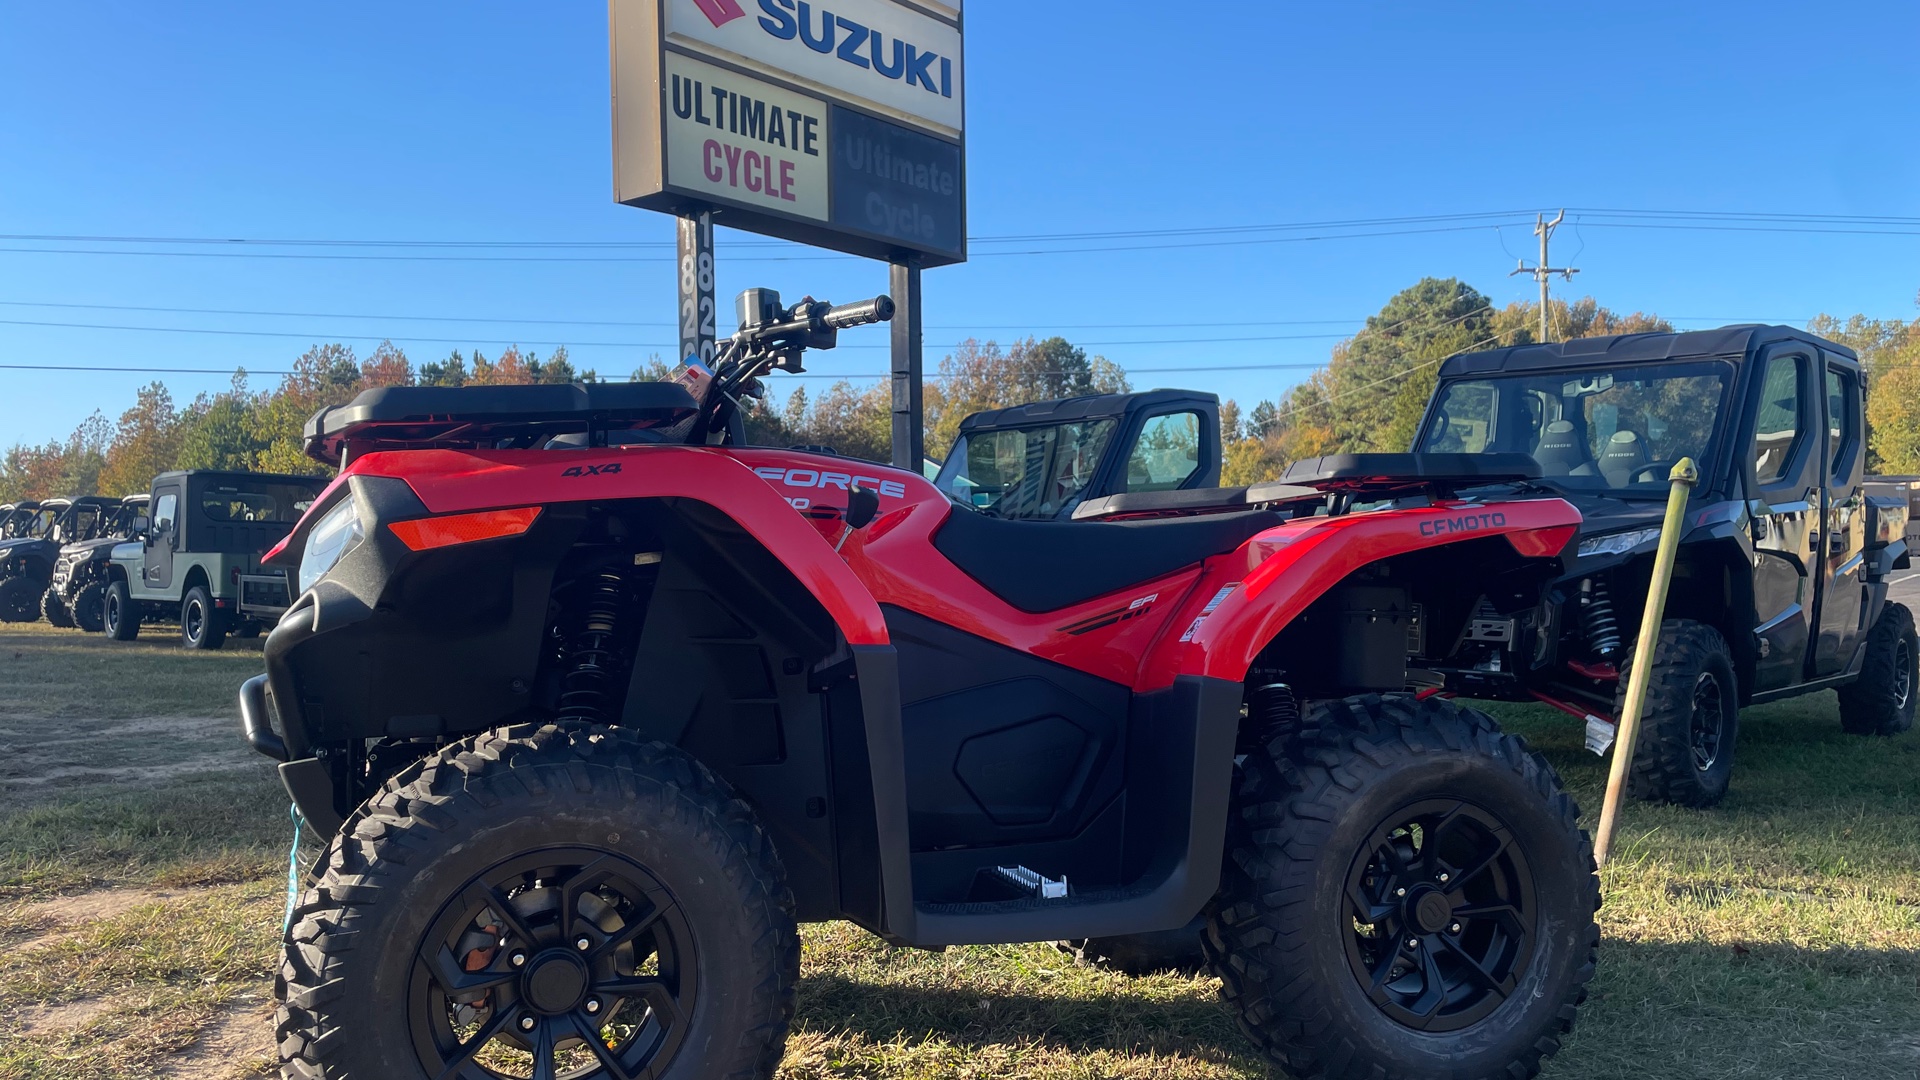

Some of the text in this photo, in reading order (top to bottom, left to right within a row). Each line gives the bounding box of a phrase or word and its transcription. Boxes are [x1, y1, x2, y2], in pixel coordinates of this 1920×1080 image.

[756, 0, 952, 99] SUZUKI
[672, 73, 819, 157] ULTIMATE
[702, 138, 797, 202] CYCLE
[845, 133, 954, 196] Ultimate
[865, 191, 936, 239] Cycle
[749, 465, 906, 499] FORCE
[1419, 512, 1506, 537] CFMOTO
[1129, 593, 1158, 609] EFI
